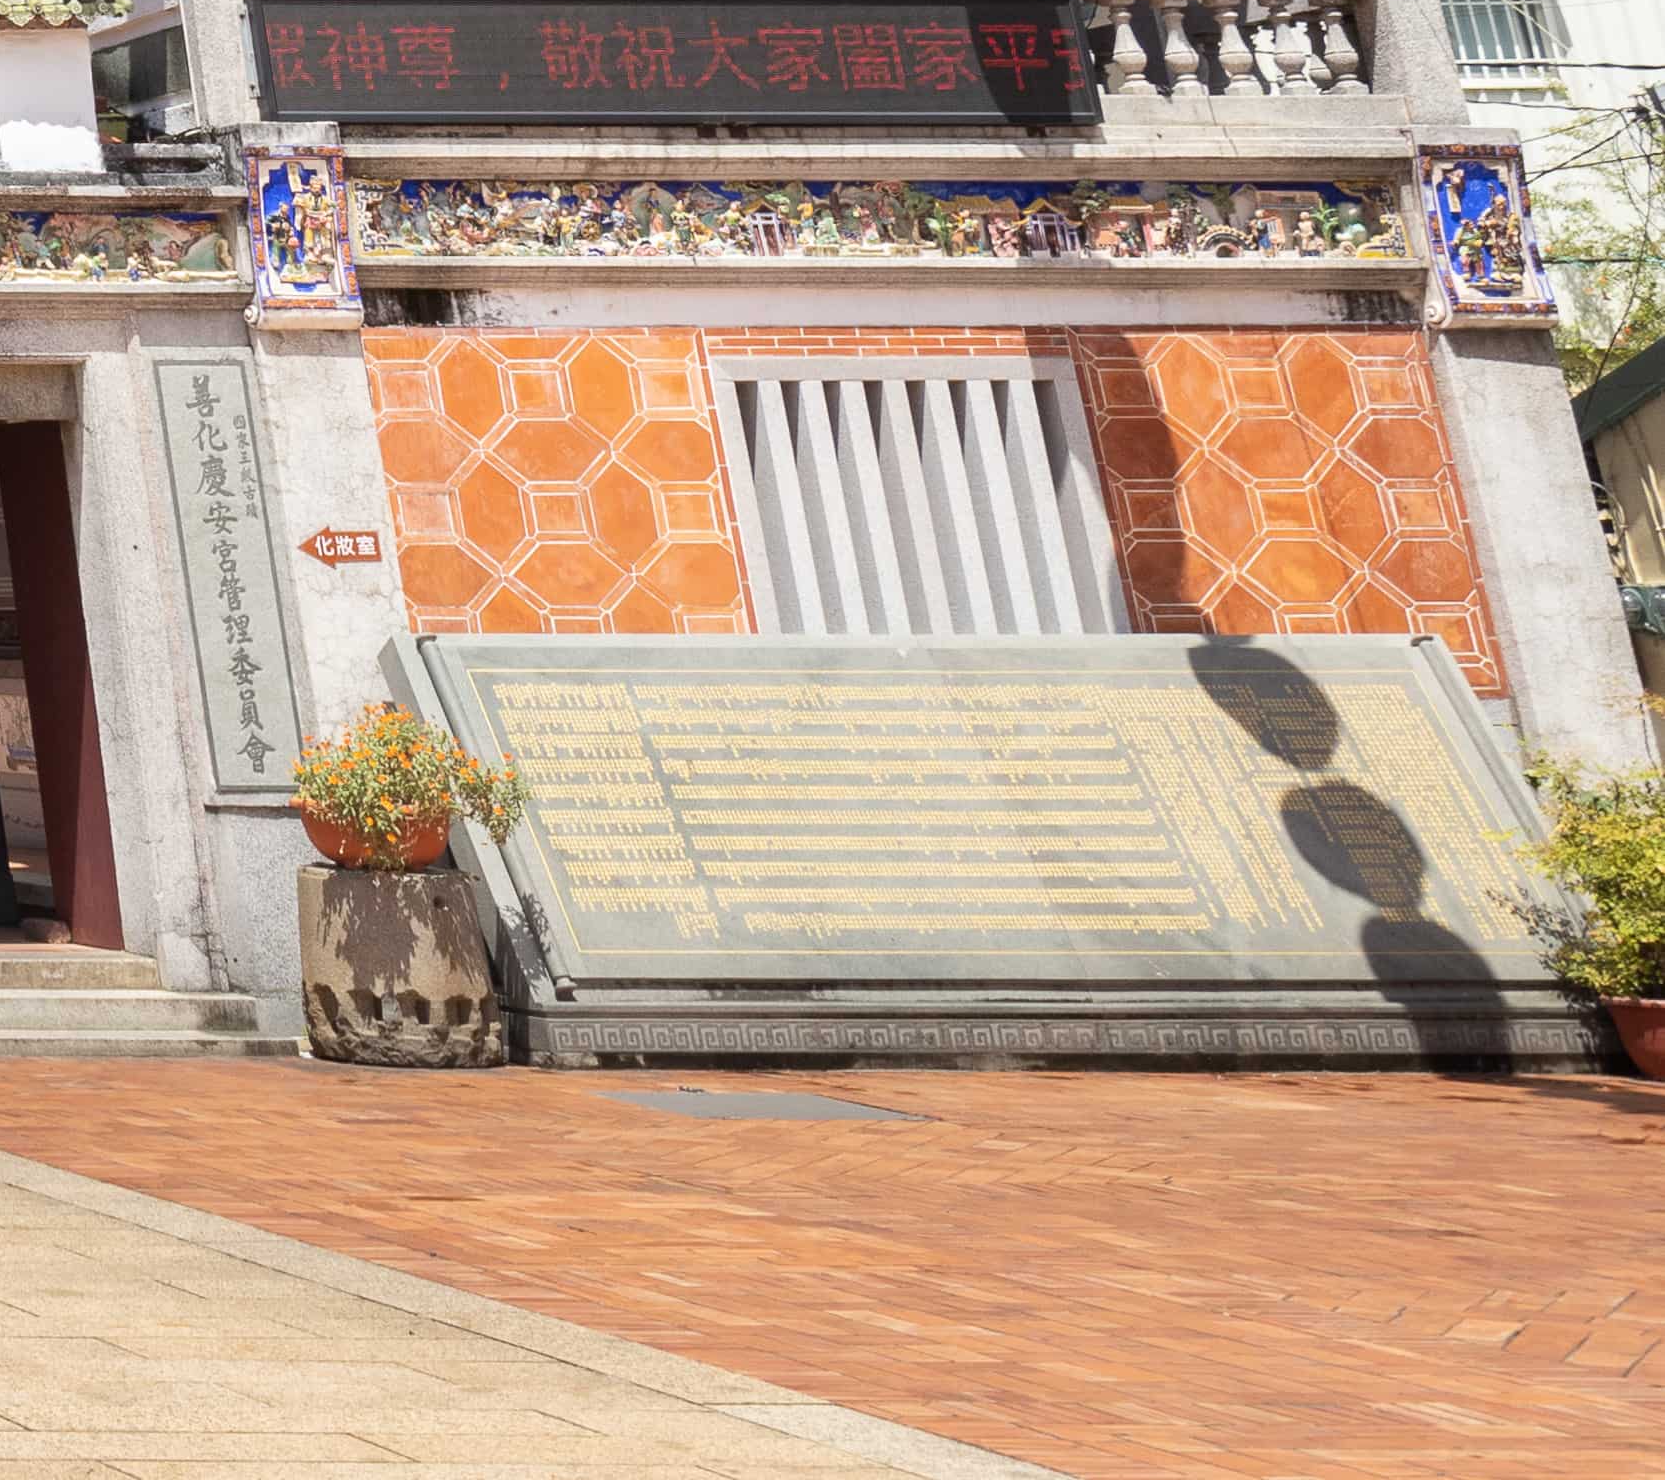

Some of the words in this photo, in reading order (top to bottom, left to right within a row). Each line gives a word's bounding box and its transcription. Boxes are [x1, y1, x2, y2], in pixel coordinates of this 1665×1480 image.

[186, 374, 276, 775] 善化慶安宮管理委員會
[315, 535, 377, 557] 化妝室
